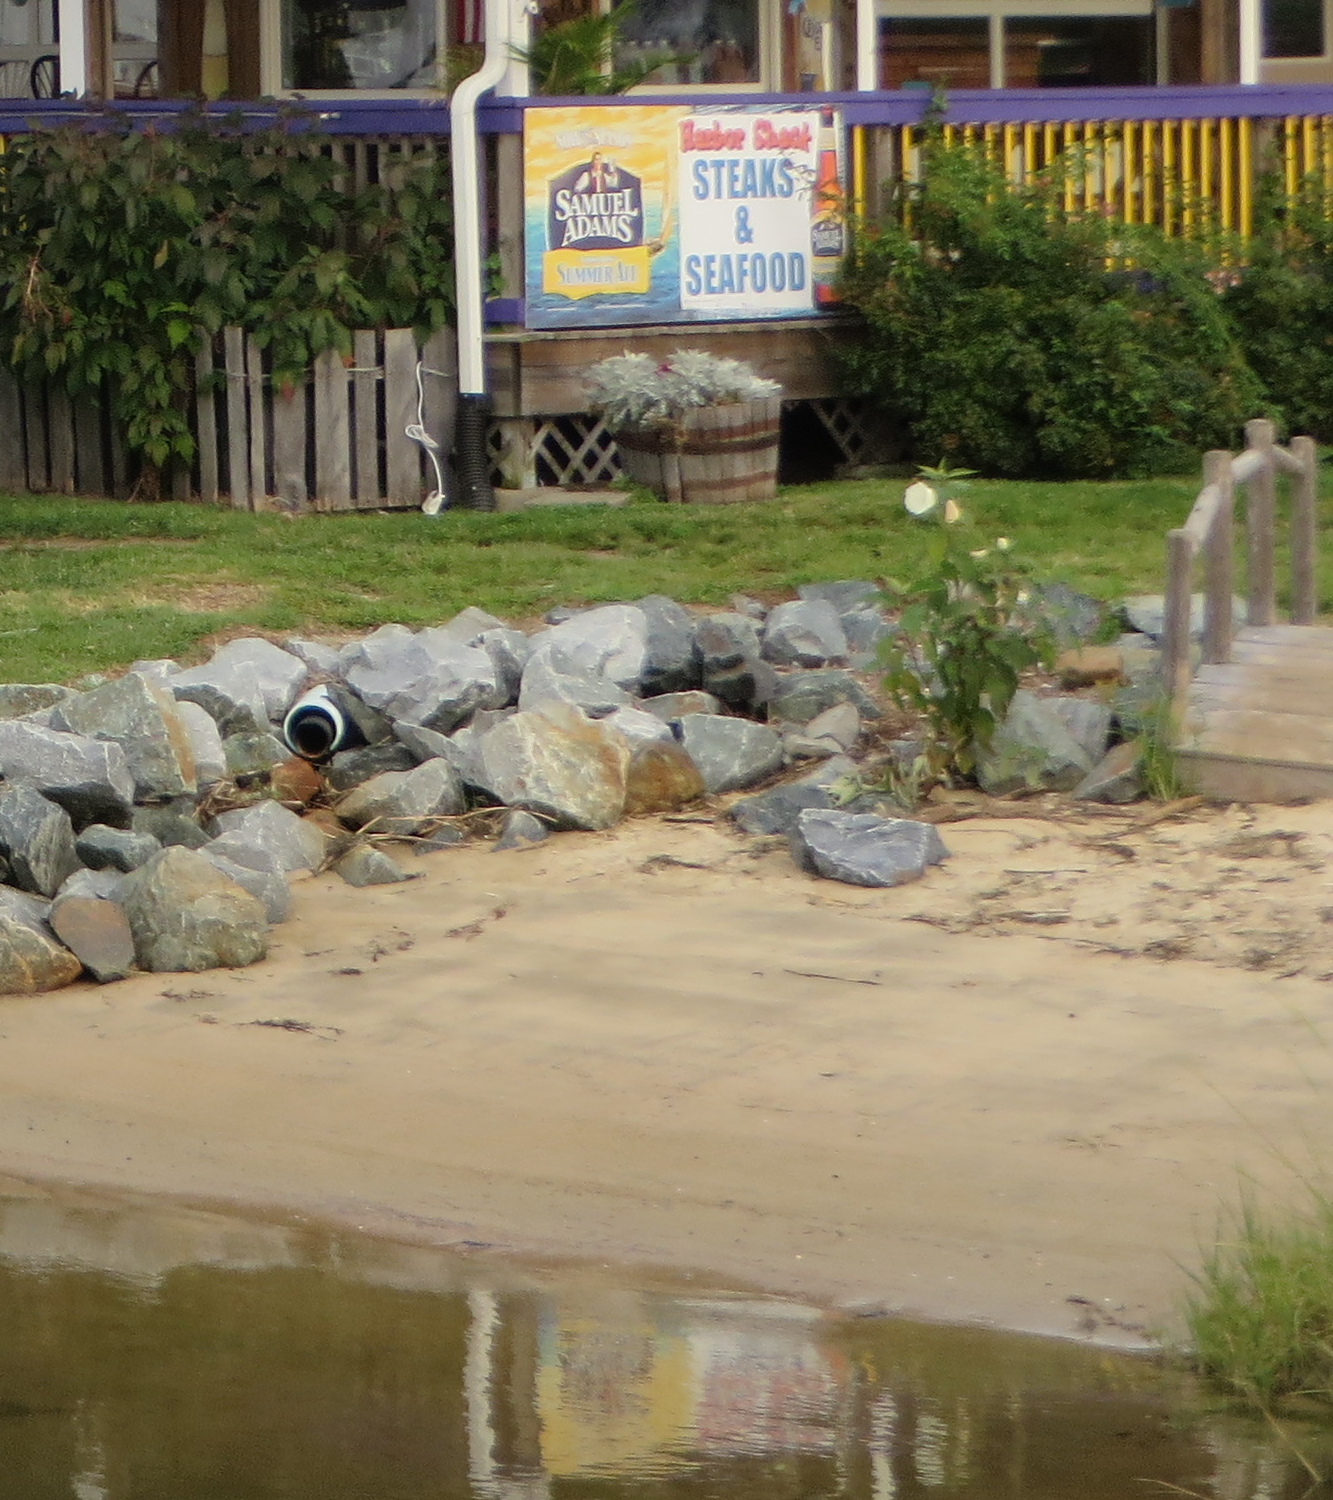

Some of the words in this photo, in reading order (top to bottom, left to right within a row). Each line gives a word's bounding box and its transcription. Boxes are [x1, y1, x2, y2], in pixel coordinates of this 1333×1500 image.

[692, 157, 795, 201] STEAKS
[555, 188, 638, 222] SAMUEL
[734, 205, 754, 244] &
[561, 216, 634, 247] ADAMS
[685, 251, 806, 296] SEAFOOD
